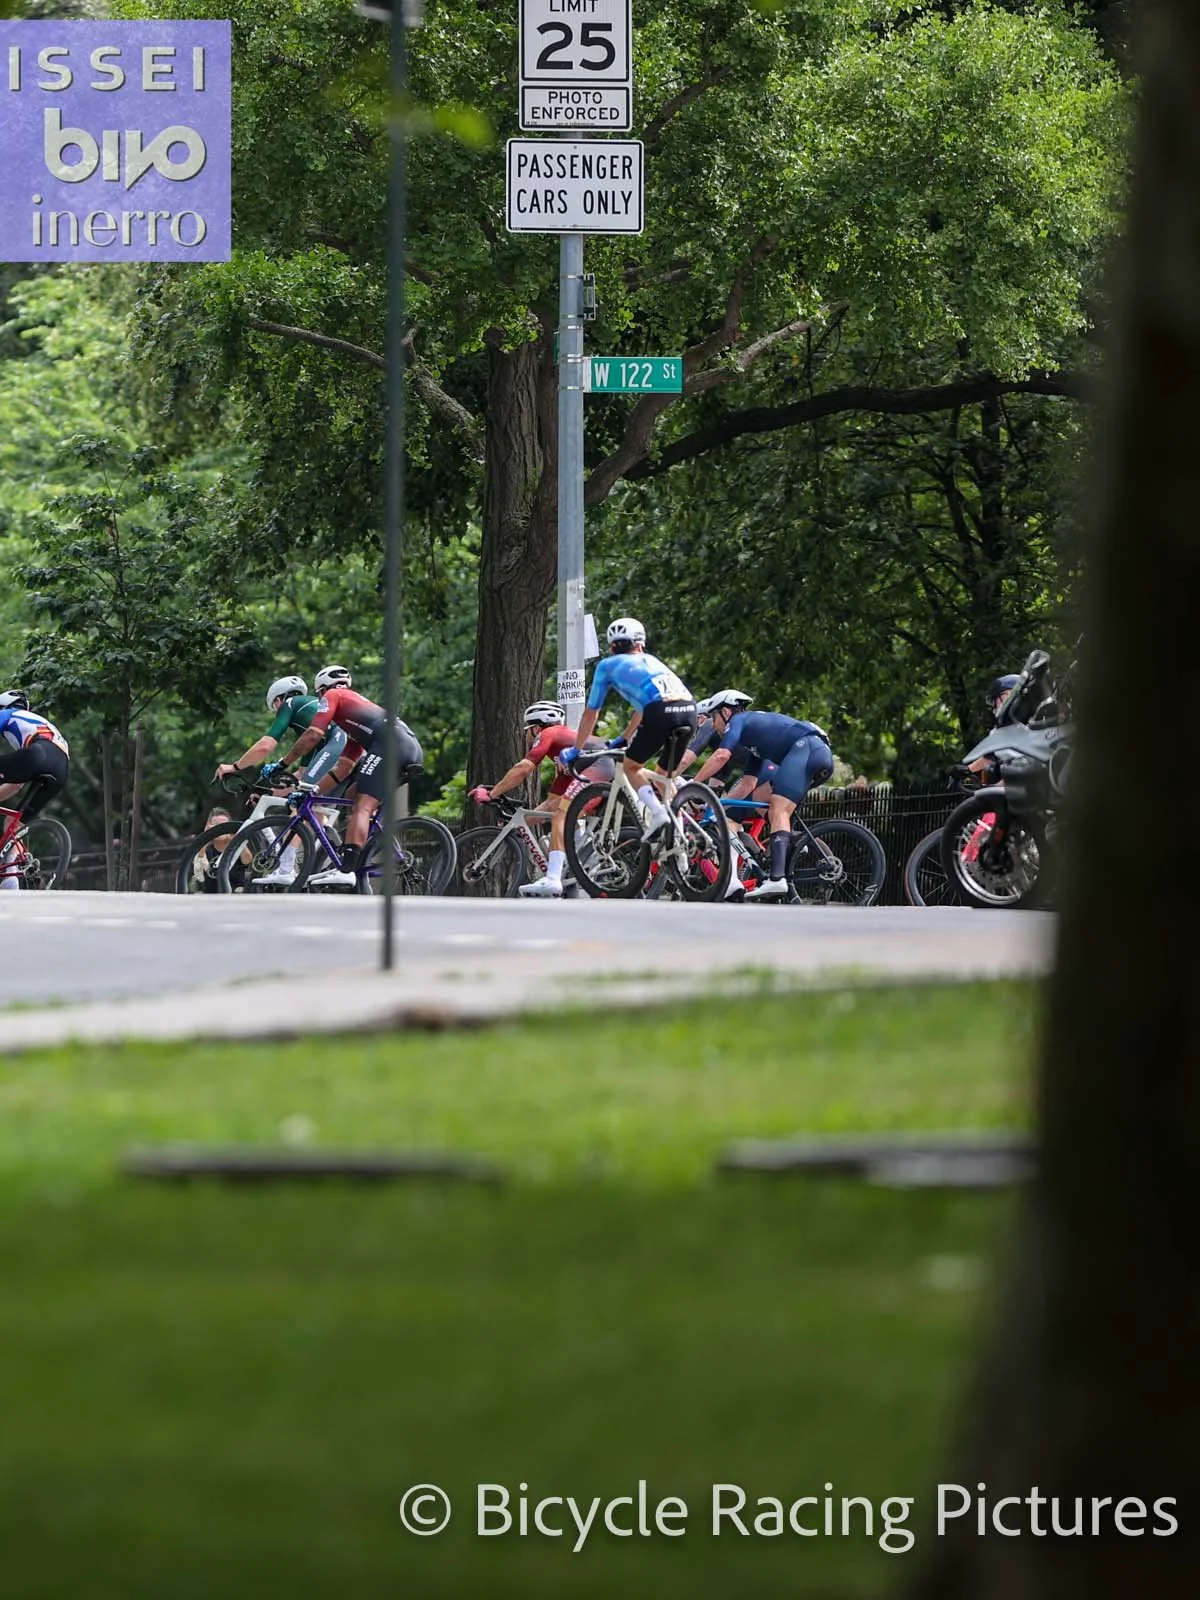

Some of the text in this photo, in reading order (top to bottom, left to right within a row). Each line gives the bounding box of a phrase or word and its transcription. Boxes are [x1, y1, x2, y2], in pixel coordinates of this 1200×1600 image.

[549, 0, 599, 12] LIMIT
[536, 21, 616, 71] 25
[548, 91, 603, 105] PHOTO
[531, 106, 620, 120] ENFORCED
[516, 153, 633, 180] PASSENGER
[516, 188, 633, 216] CARS ONLY
[594, 362, 677, 388] W 122 St
[565, 671, 578, 680] NO
[557, 680, 586, 691] PARKIN
[557, 691, 585, 700] SATURDA
